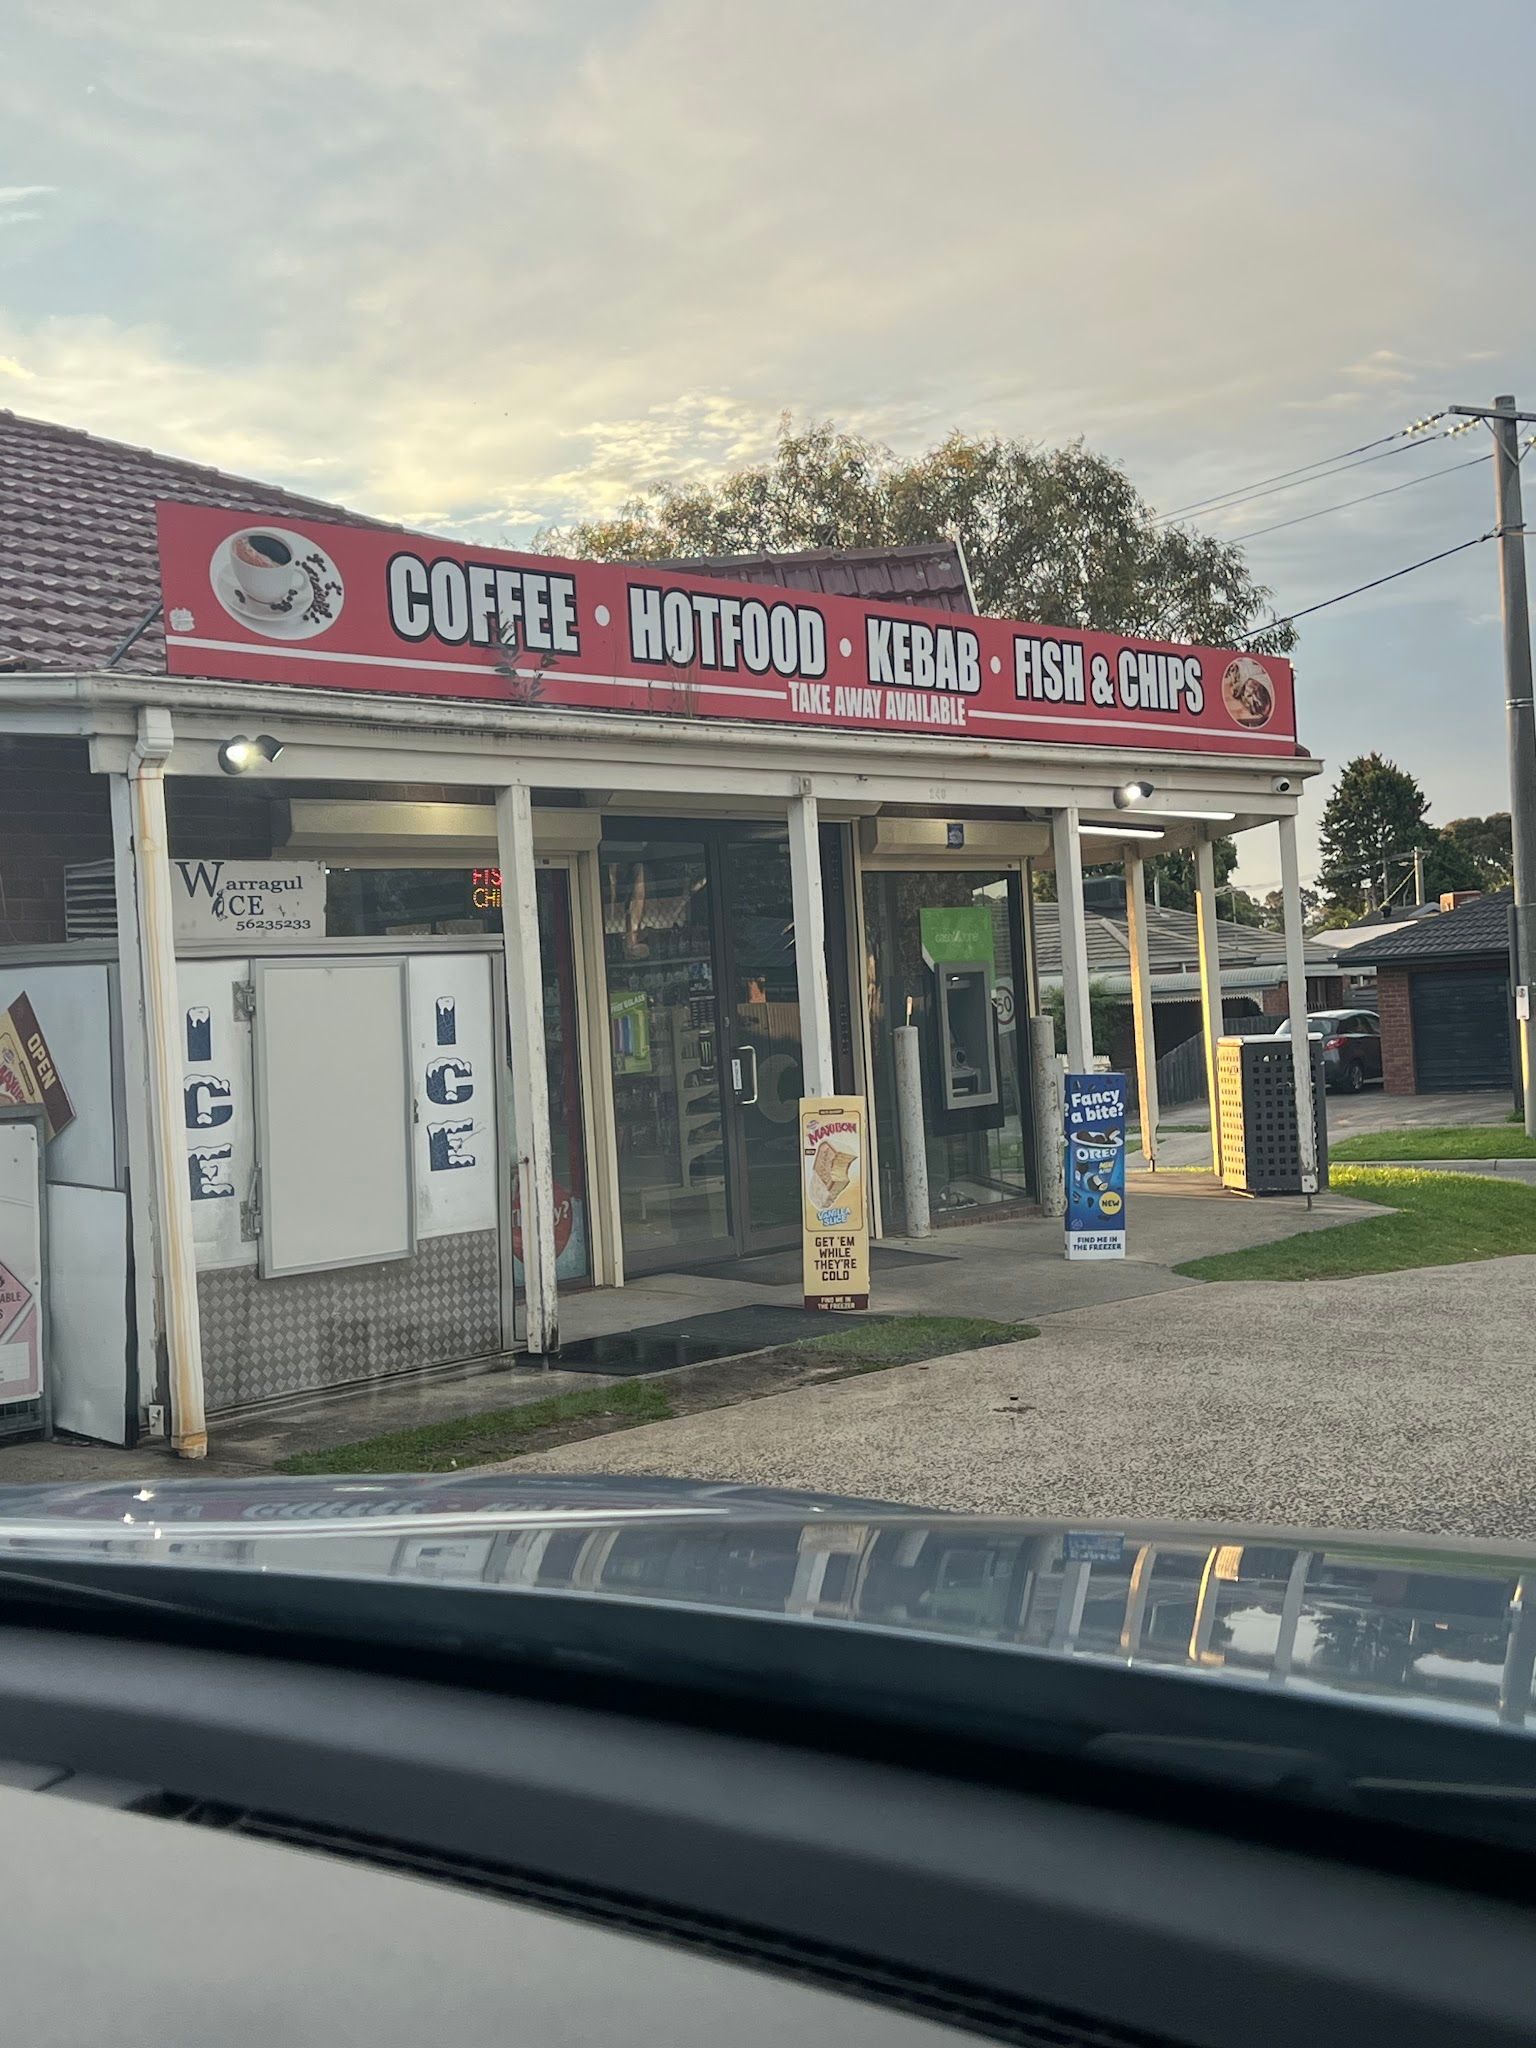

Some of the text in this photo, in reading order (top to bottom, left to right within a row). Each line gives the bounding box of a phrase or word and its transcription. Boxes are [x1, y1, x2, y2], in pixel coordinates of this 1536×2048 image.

[387, 552, 1203, 714] COFFEE HOTFOOD KEBAB FISH & CHIPS
[788, 681, 966, 726] TAKE AWAY AVAILABLE
[175, 862, 303, 897] Warragul
[472, 868, 503, 886] FIS
[473, 888, 502, 908] CHI
[236, 918, 311, 931] 56235233
[28, 1033, 56, 1090] OPEN
[1071, 1090, 1120, 1107] Fancy
[1071, 1112, 1083, 1123] a
[1085, 1102, 1124, 1121] bite?
[807, 1122, 857, 1145] MAXIBON
[1076, 1148, 1117, 1160] OREO
[822, 1214, 848, 1227] SLICE
[815, 1236, 855, 1247] GET 'EM
[1089, 1243, 1122, 1251] FREEZER
[819, 1248, 851, 1258] WHILE
[814, 1259, 857, 1270] THEY'RE
[822, 1271, 850, 1281] COLD
